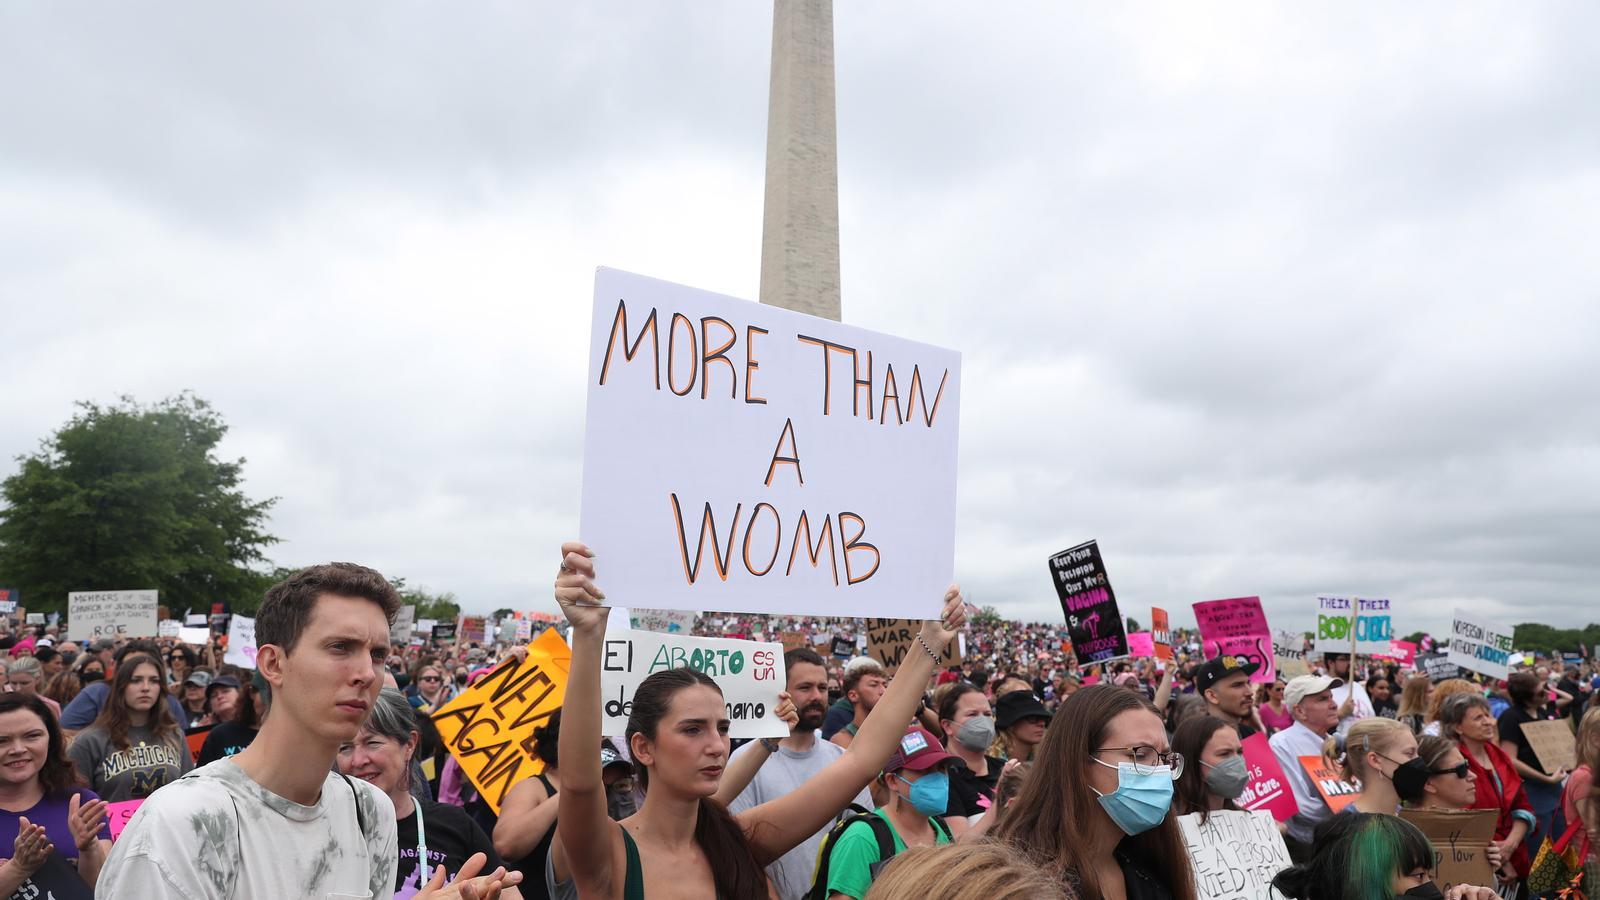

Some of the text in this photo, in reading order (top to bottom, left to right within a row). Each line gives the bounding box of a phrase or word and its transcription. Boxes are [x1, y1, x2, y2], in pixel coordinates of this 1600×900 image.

[599, 298, 948, 428] MORE THAN
[764, 417, 804, 487] A
[671, 493, 880, 586] WOMB
[1065, 587, 1109, 612] VAGINA
[1318, 597, 1390, 610] THEIR THEIR
[94, 625, 127, 636] ROE
[870, 629, 912, 645] WAR
[1318, 614, 1354, 641] BODY
[1495, 634, 1514, 652] FREE
[648, 644, 744, 677] ABORTO
[752, 651, 775, 666] es
[754, 666, 776, 681] un
[431, 703, 524, 807] AGAIN
[131, 767, 168, 794] M
[1253, 764, 1263, 778] is
[1255, 778, 1280, 797] Care.
[400, 848, 447, 863] AGANST
[1227, 840, 1284, 864] PERSON
[1449, 830, 1475, 862] Your
[1197, 867, 1246, 898] NIED
